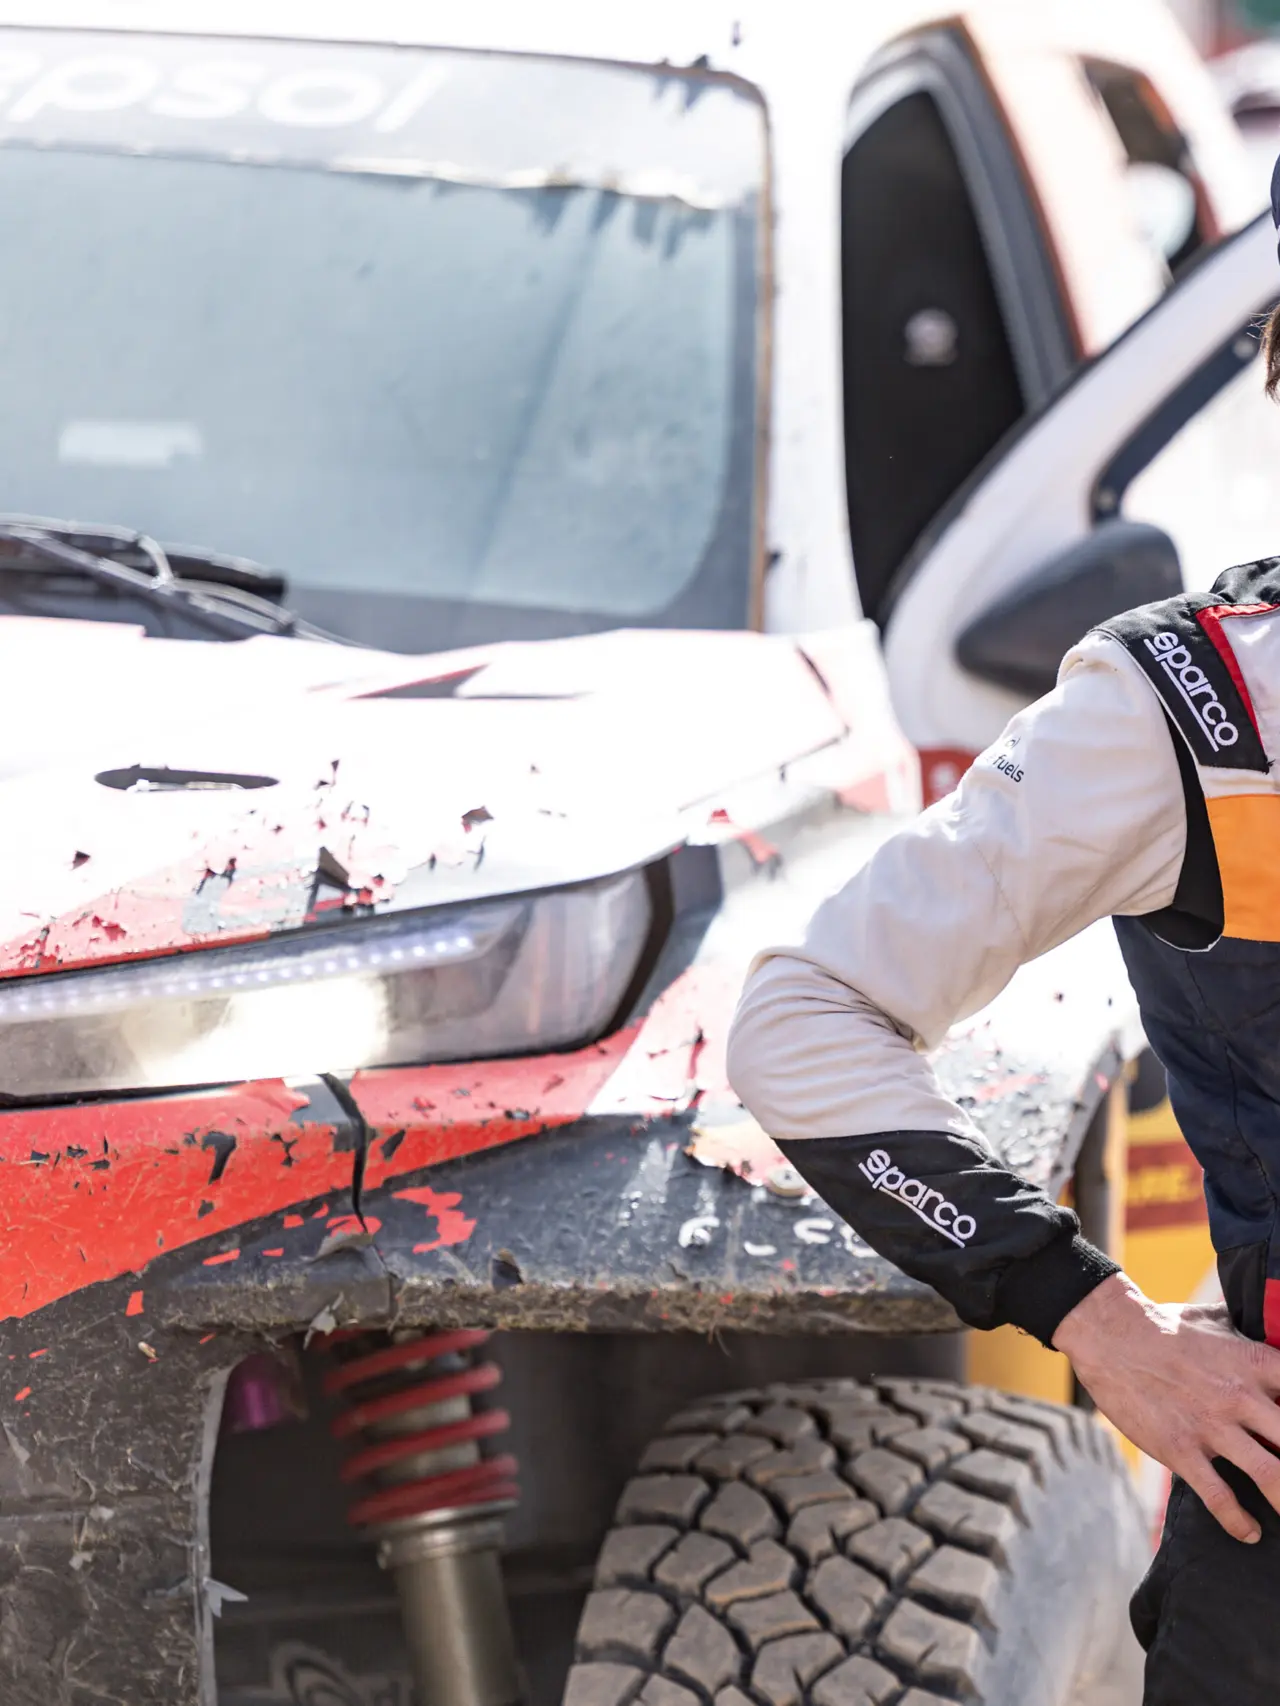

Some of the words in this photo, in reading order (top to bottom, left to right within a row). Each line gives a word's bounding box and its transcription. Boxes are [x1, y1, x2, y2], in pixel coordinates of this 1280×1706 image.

[0, 48, 454, 134] psol
[1150, 632, 1239, 748] sparco
[992, 754, 1024, 783] fuels
[863, 1149, 977, 1243] sparco
